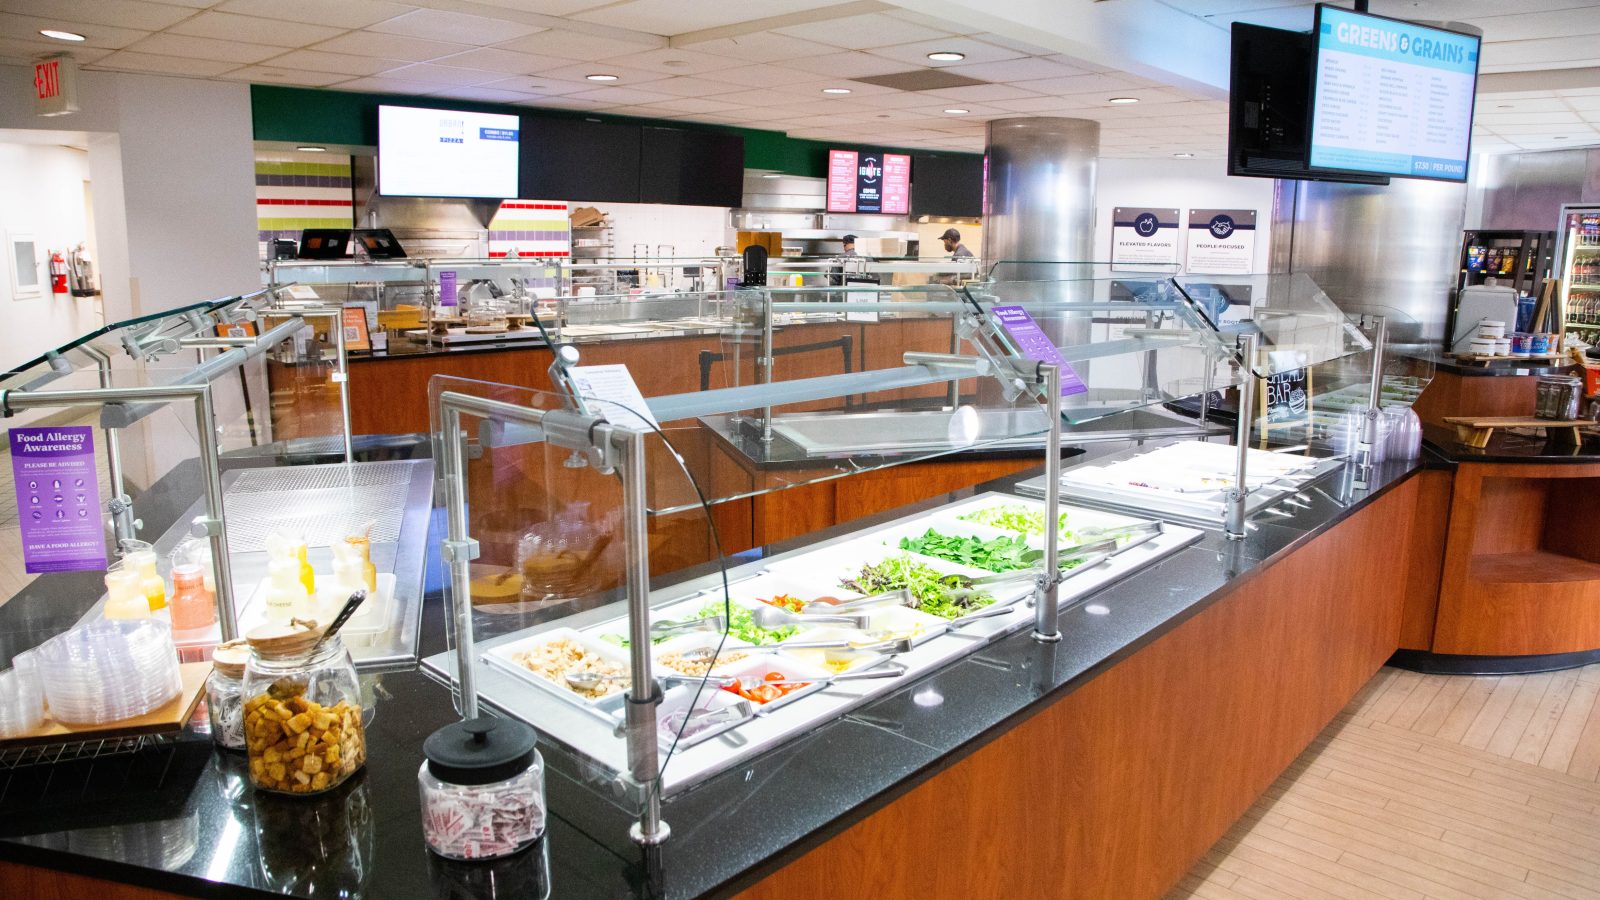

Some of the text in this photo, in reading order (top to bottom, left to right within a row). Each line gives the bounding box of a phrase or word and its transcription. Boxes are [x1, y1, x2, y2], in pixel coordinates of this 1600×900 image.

[1337, 22, 1397, 52] GREENS
[1412, 37, 1464, 64] GRAINS
[35, 61, 60, 99] EXIT
[859, 166, 881, 177] IGNITE
[1432, 163, 1443, 171] PER
[1444, 164, 1463, 173] POUND
[1267, 383, 1291, 406] BAR
[16, 432, 86, 443] Food Allergy
[23, 443, 83, 453] Awareness
